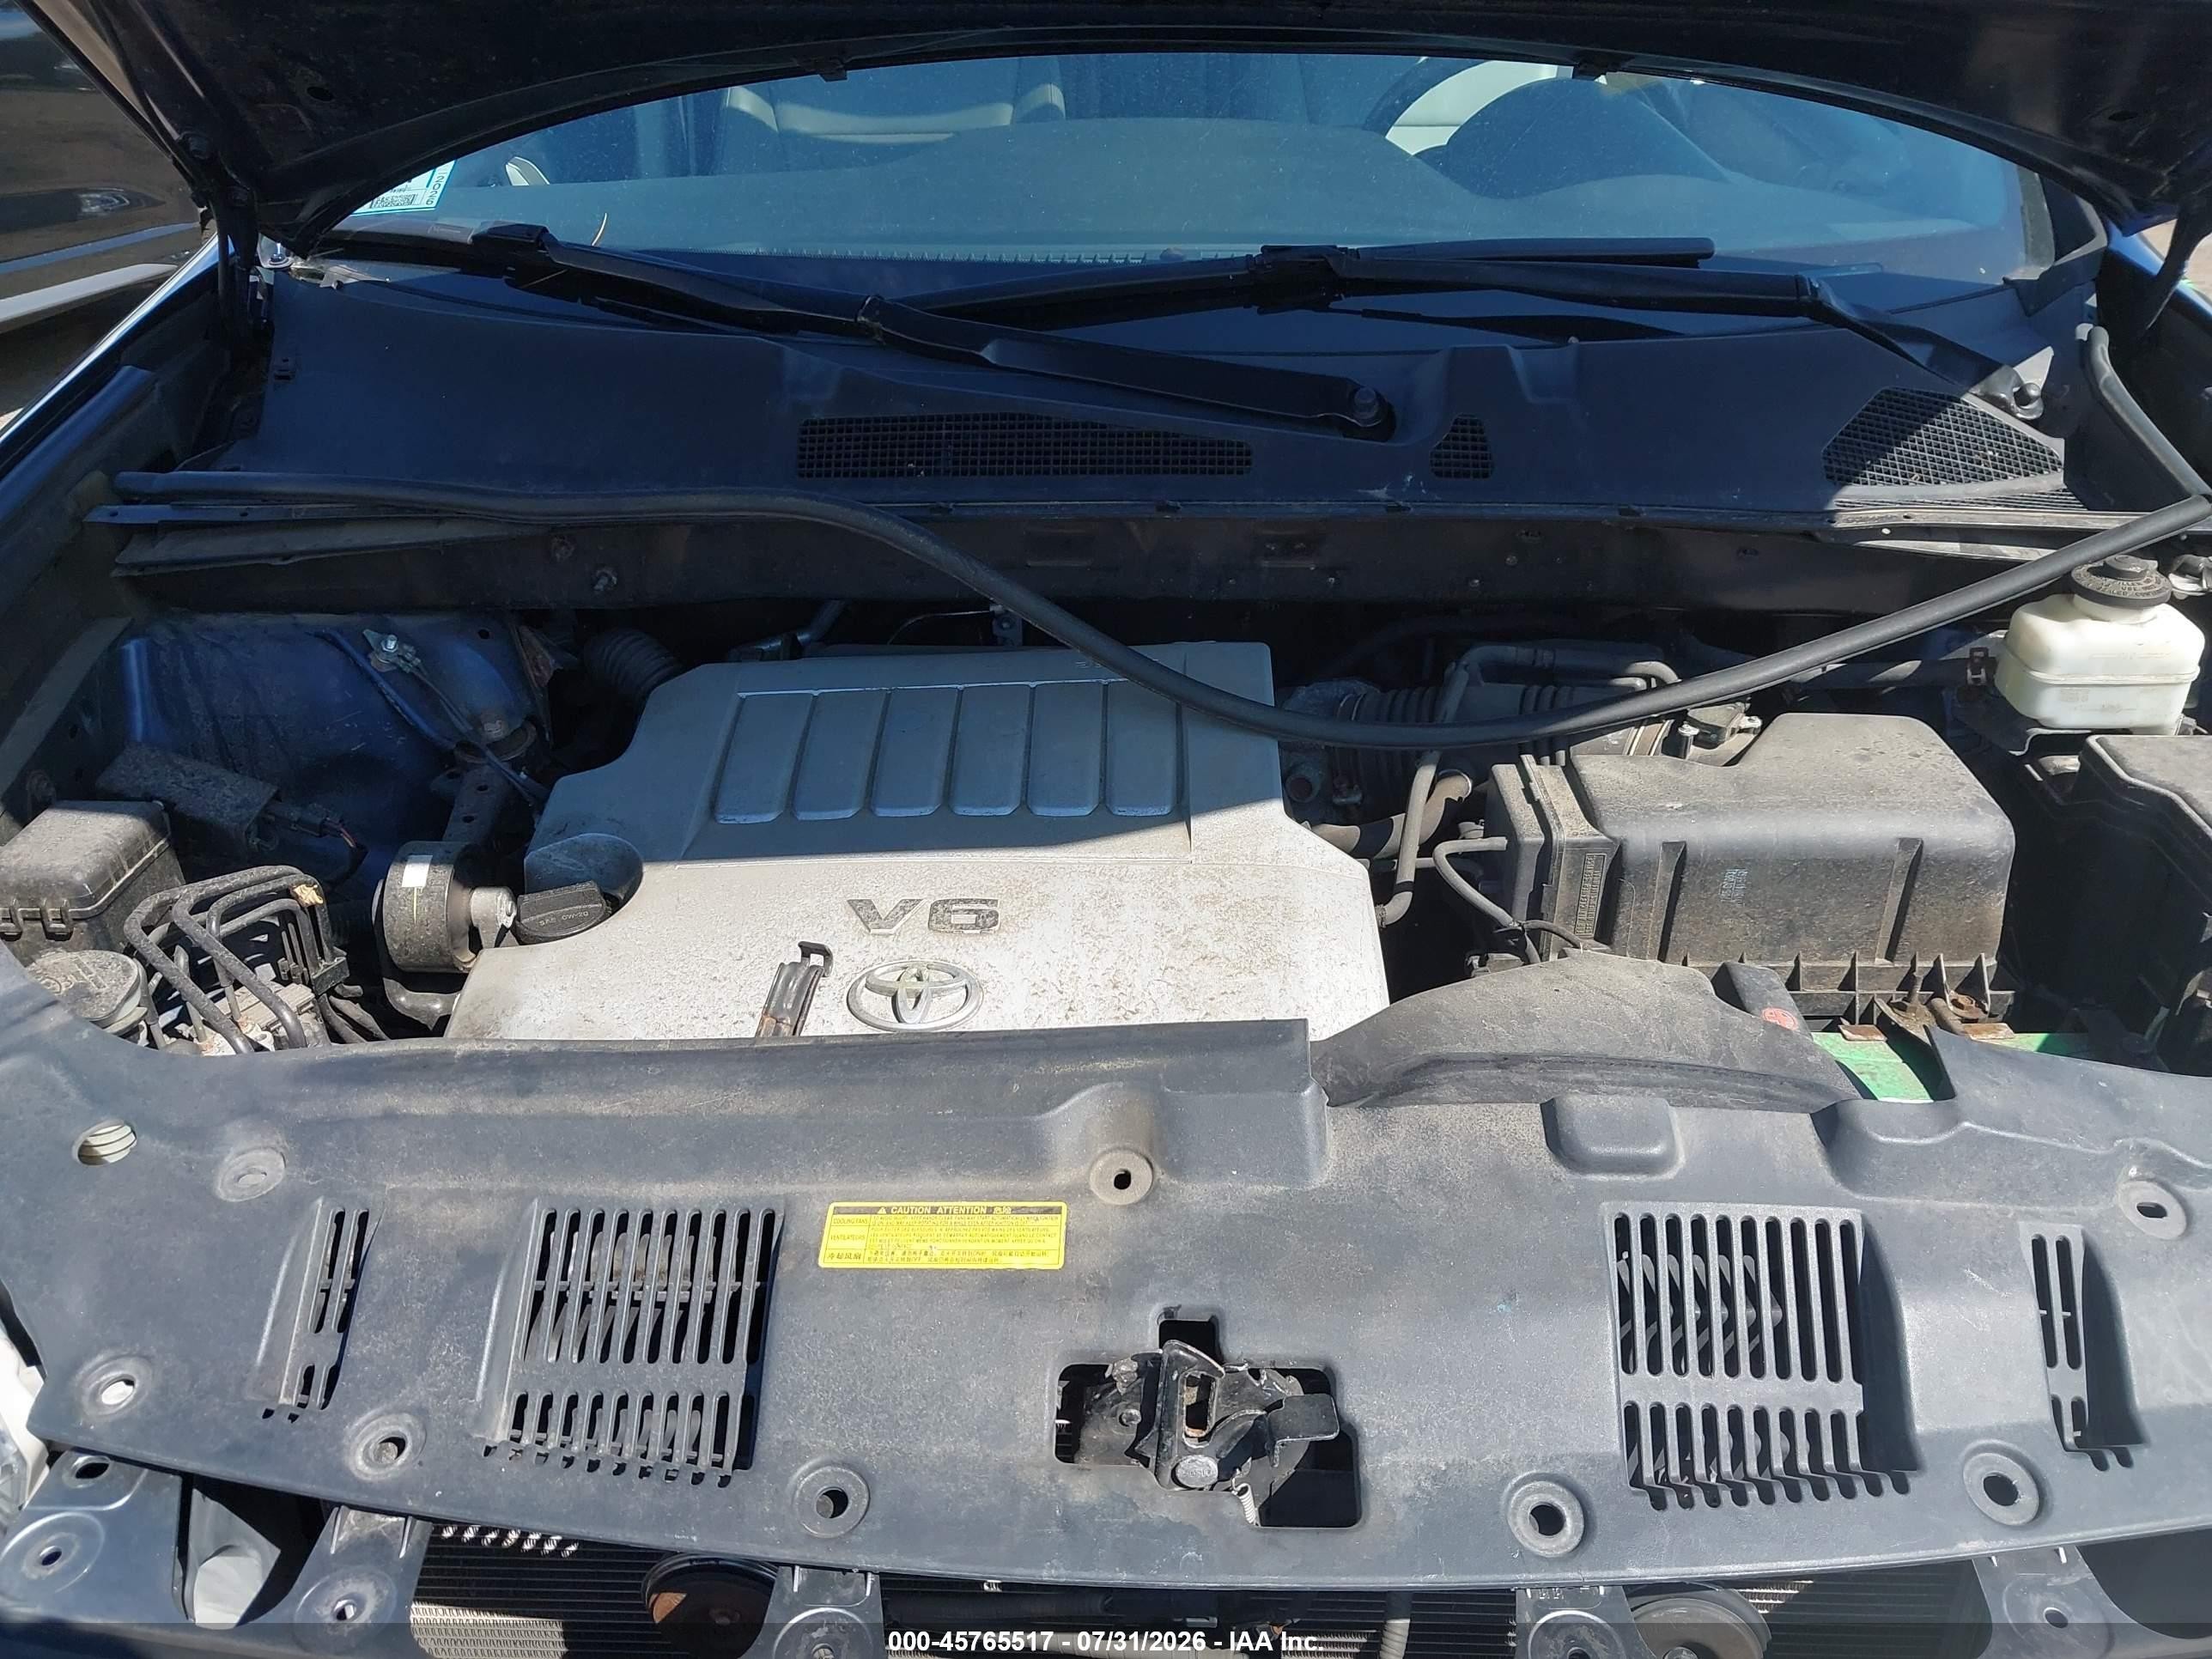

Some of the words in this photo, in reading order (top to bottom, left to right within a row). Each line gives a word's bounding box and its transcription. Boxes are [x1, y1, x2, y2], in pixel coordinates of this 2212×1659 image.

[426, 174, 445, 205] 2026
[538, 917, 557, 927] SAE
[847, 898, 1000, 934] V6
